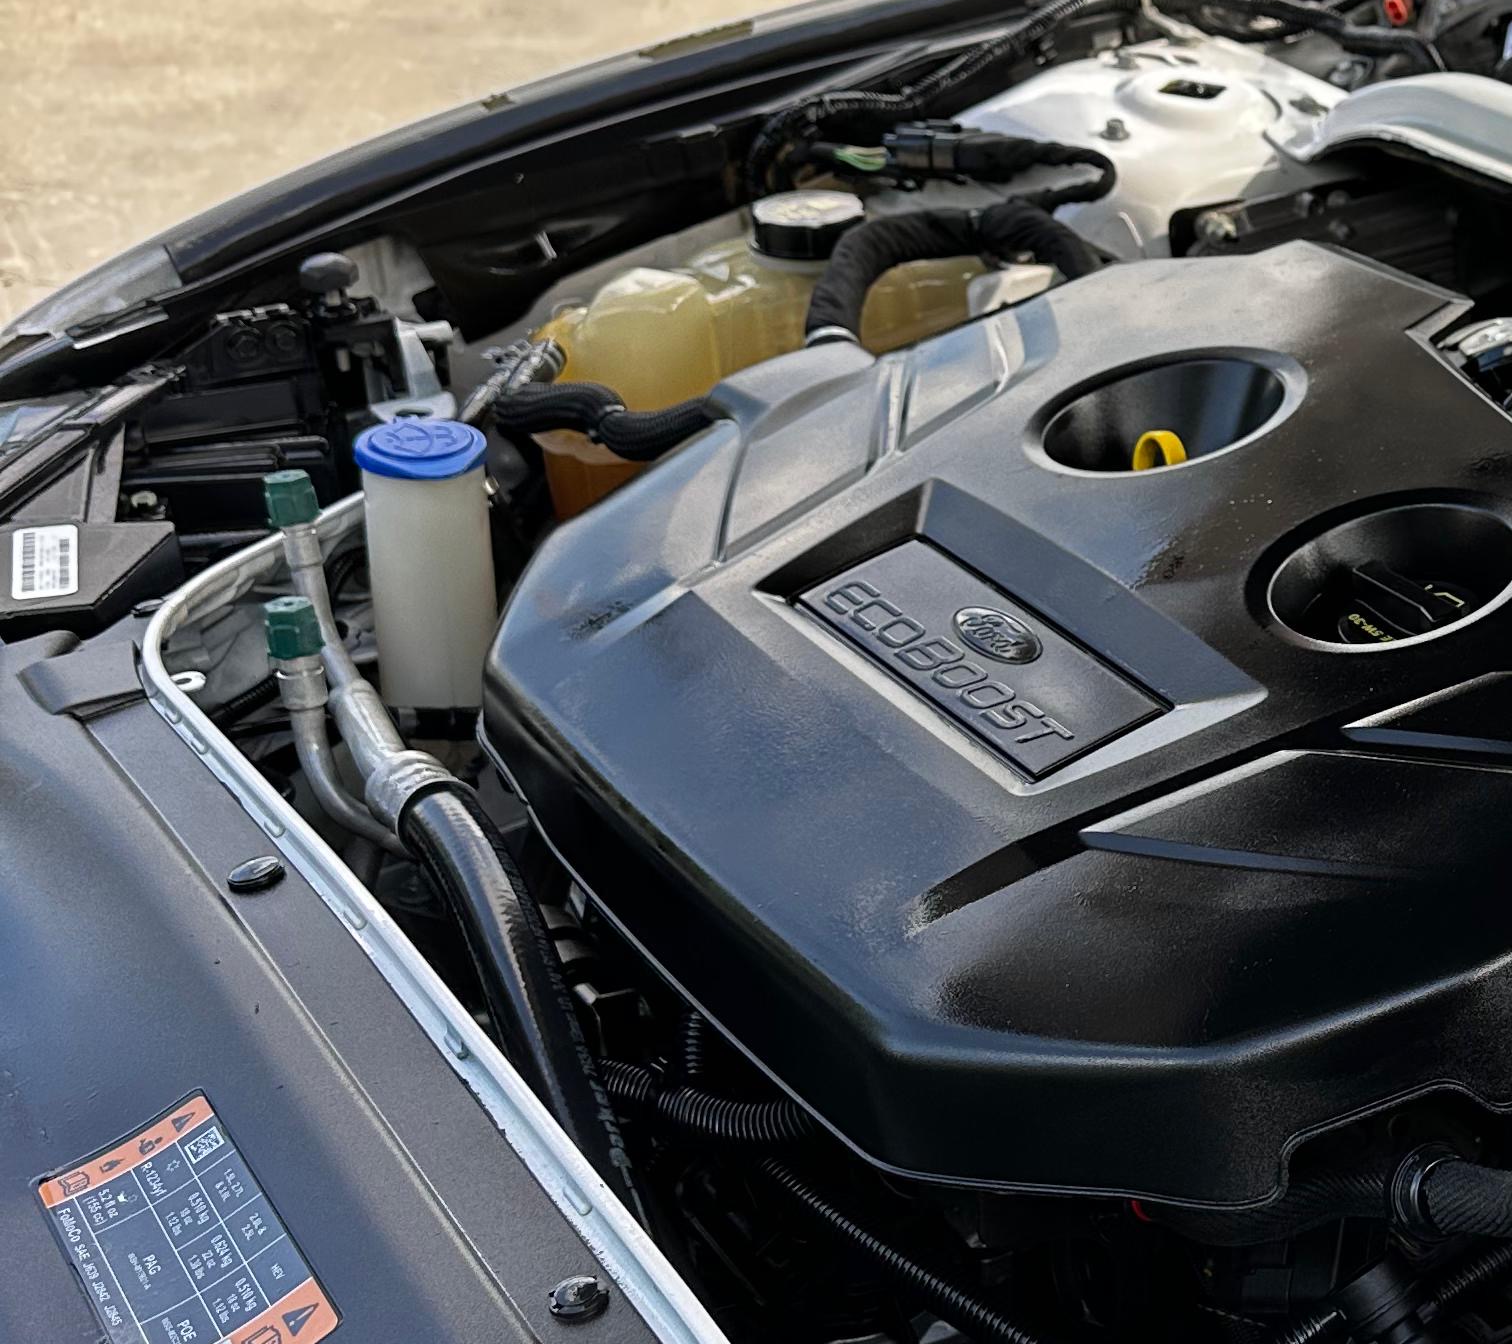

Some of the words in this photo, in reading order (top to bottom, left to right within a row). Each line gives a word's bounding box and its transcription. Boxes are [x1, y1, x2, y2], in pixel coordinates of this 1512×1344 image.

[957, 611, 1033, 657] Ford
[822, 581, 1075, 744] ECOBOOST
[74, 1244, 90, 1261] SAE
[142, 1254, 161, 1275] PAG
[177, 1319, 197, 1342] POE
